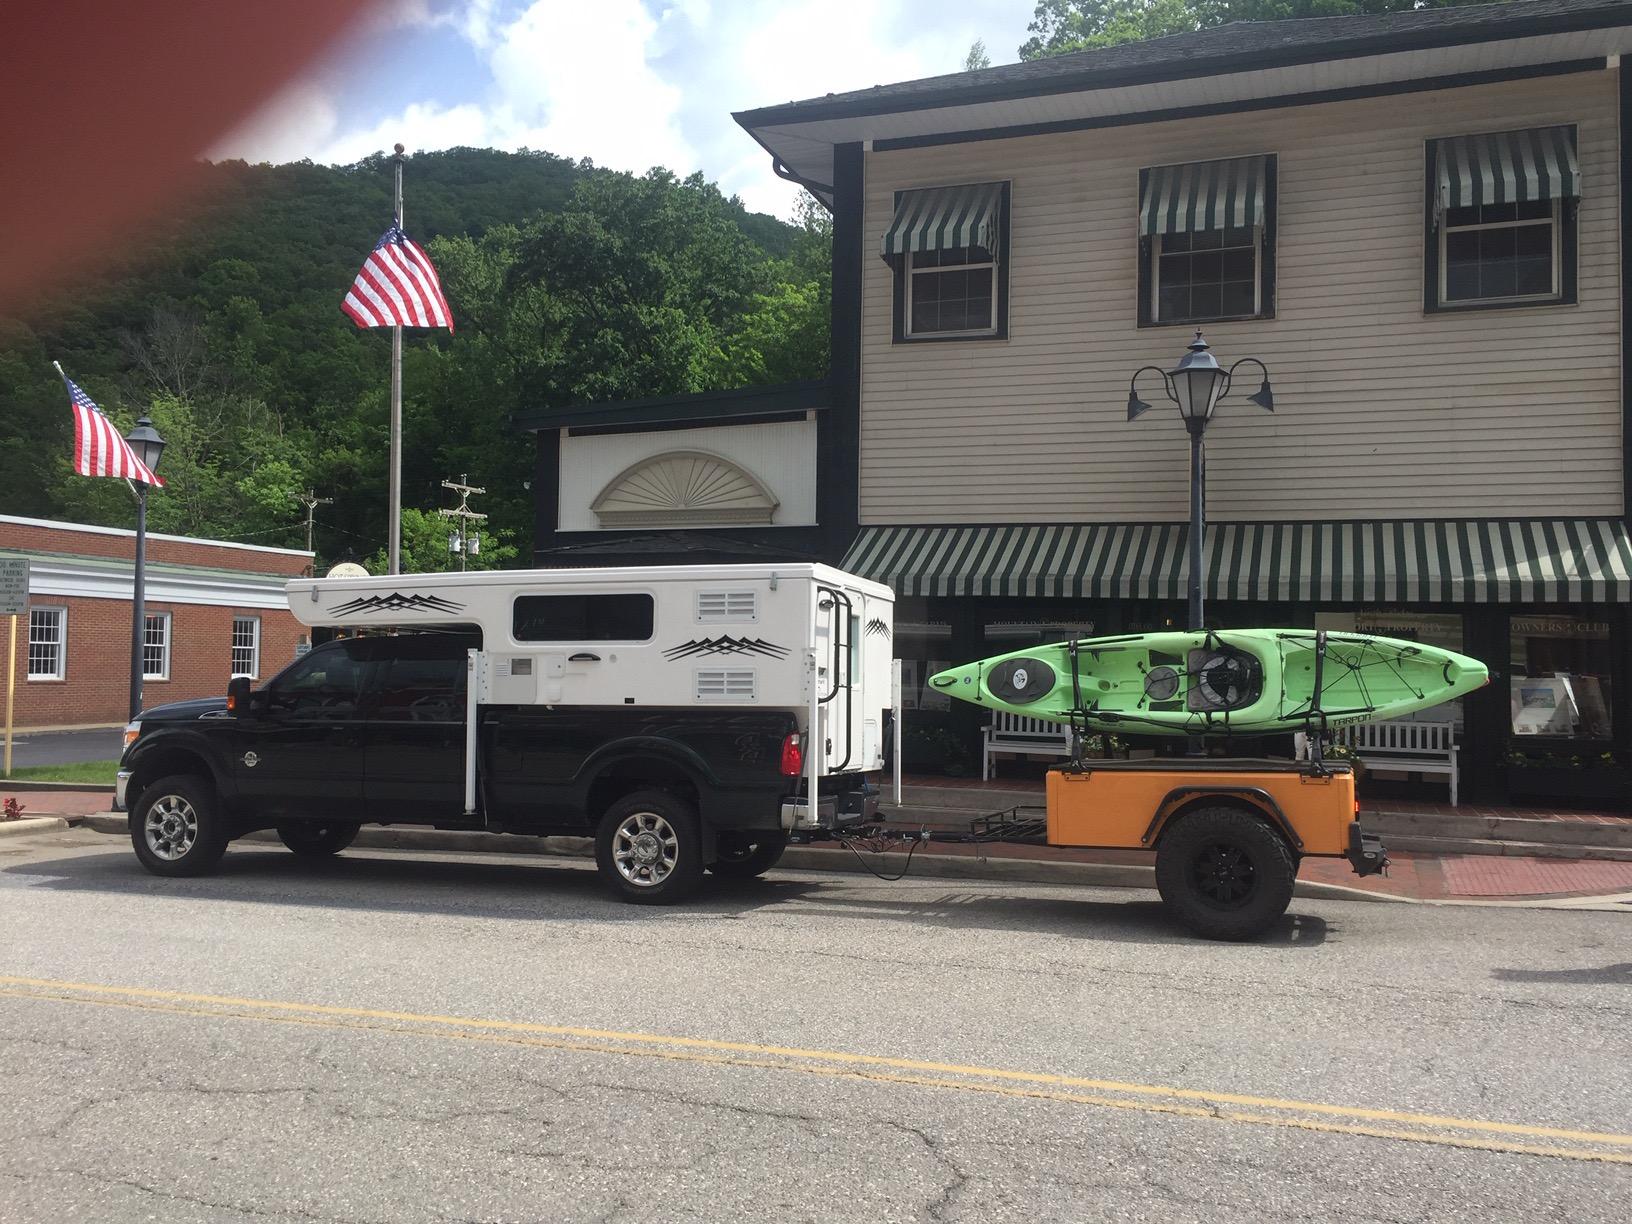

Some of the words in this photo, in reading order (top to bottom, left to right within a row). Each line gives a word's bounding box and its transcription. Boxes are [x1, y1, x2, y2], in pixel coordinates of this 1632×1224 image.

[1511, 623, 1563, 632] OWNERS
[1577, 623, 1610, 632] CLUB
[1332, 713, 1372, 726] TARPON
